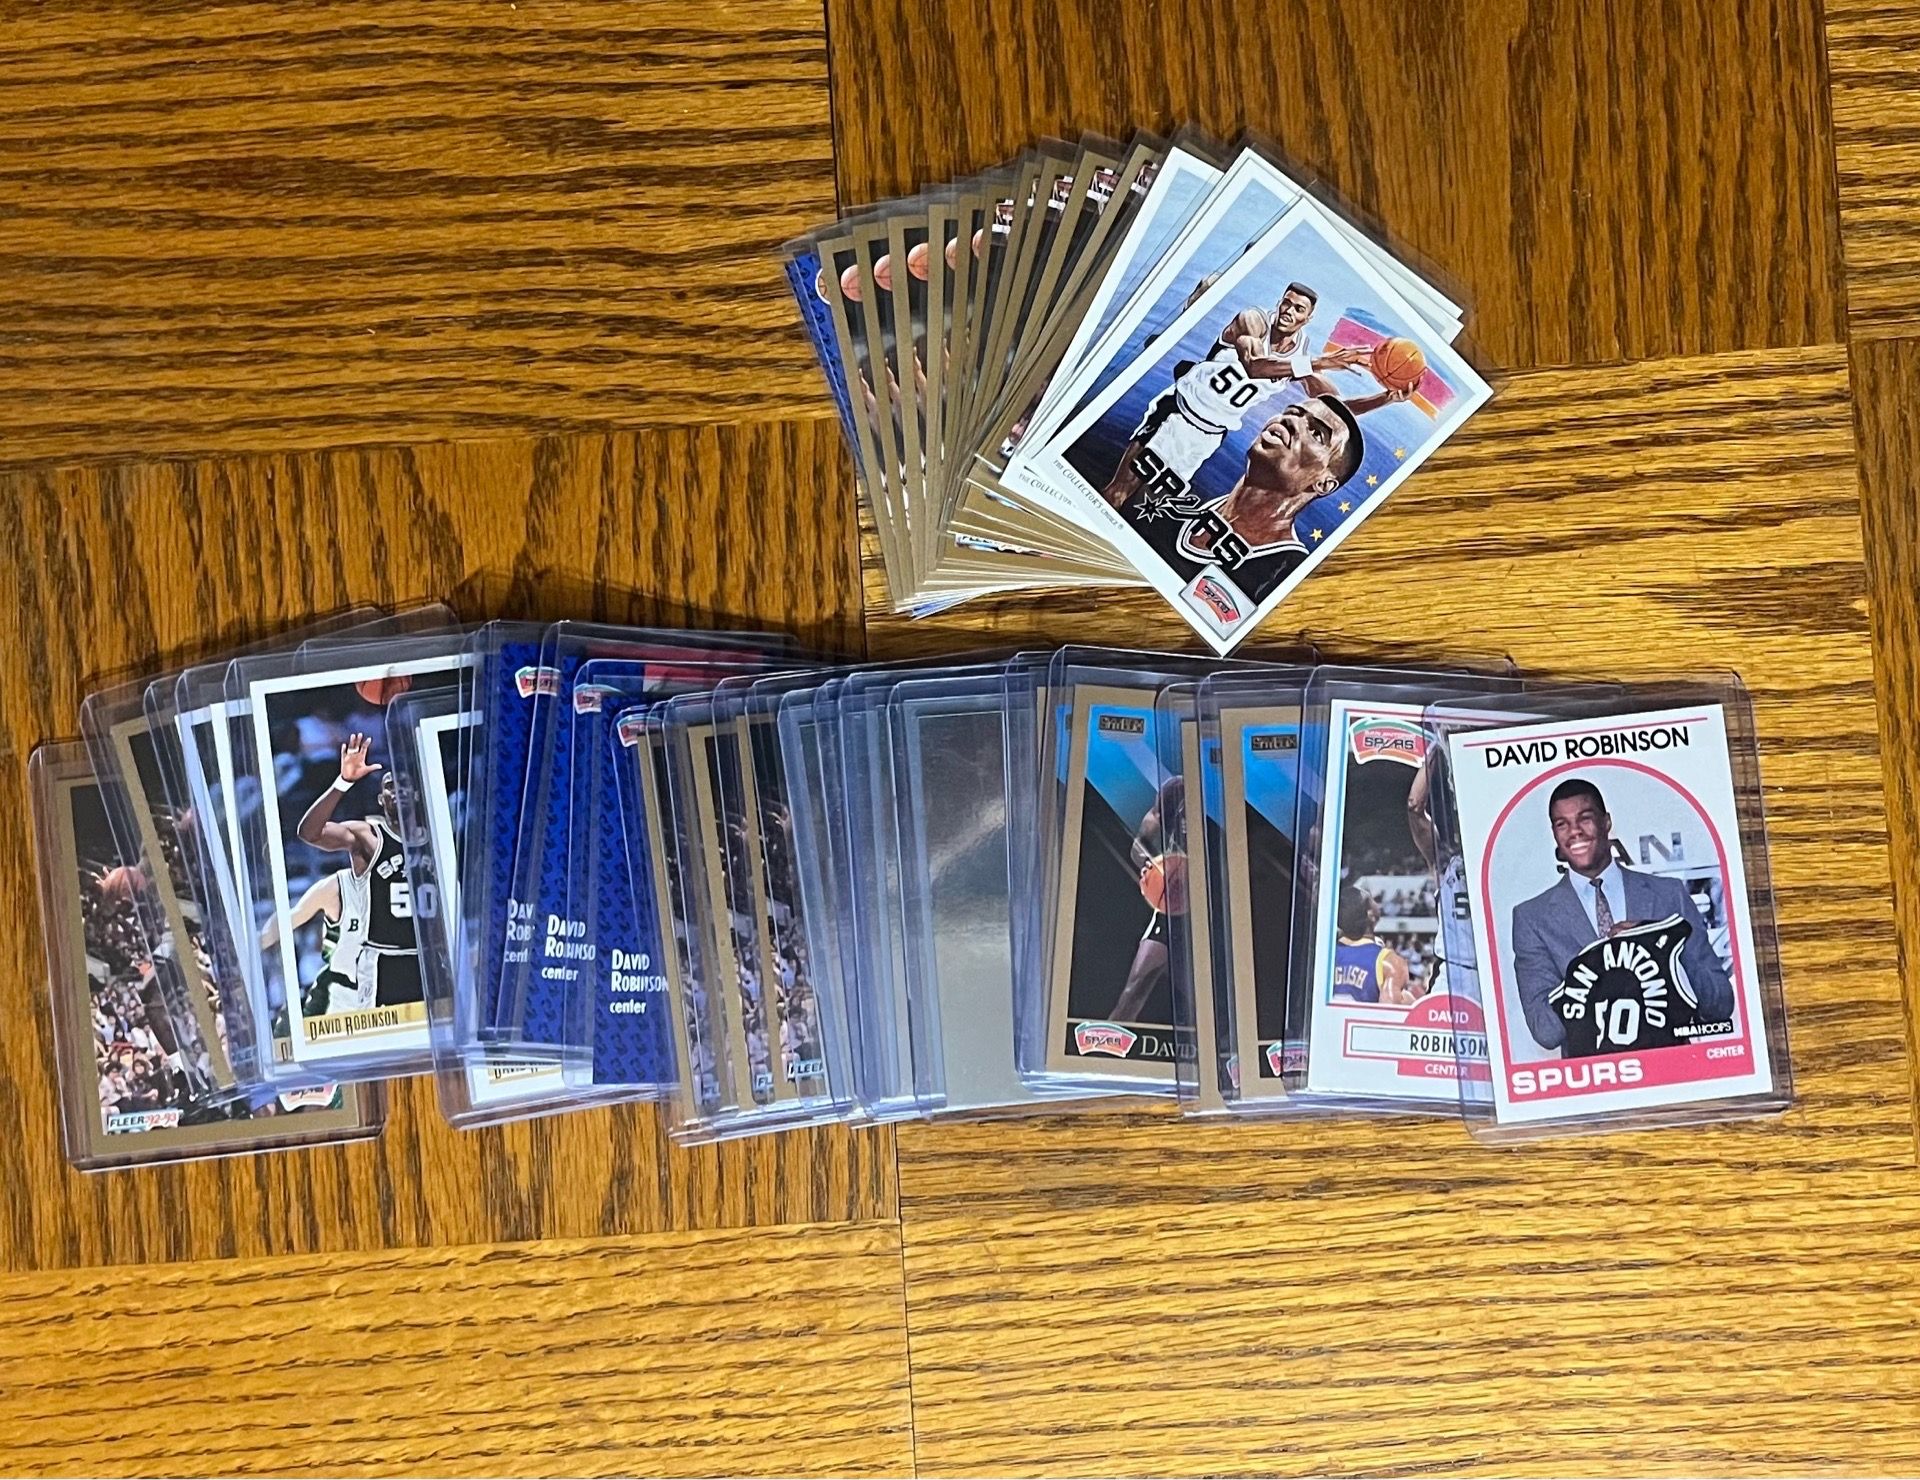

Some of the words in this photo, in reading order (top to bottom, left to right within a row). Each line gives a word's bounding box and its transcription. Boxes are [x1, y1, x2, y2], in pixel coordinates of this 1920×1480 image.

[1210, 365, 1258, 408] 50
[1486, 742, 1557, 768] DAVID
[1565, 726, 1689, 759] ROBINSON
[390, 882, 437, 918] 50
[348, 918, 359, 932] B
[547, 914, 586, 938] DAVID
[611, 949, 650, 970] DAVID
[541, 966, 578, 981] center
[1563, 964, 1599, 1019] SAN
[1603, 941, 1668, 1028] ANTONIO
[609, 999, 646, 1014] center
[1428, 1009, 1469, 1024] DAVID
[309, 1019, 342, 1041] DAVID
[345, 1010, 399, 1036] ROBINSON
[1140, 1035, 1197, 1059] DAVID
[1410, 1033, 1488, 1057] ROBINSON
[1706, 1045, 1745, 1060] CENTER
[1424, 1063, 1469, 1077] CENTER
[1511, 1059, 1644, 1095] SPURS
[109, 1116, 145, 1128] FLEER
